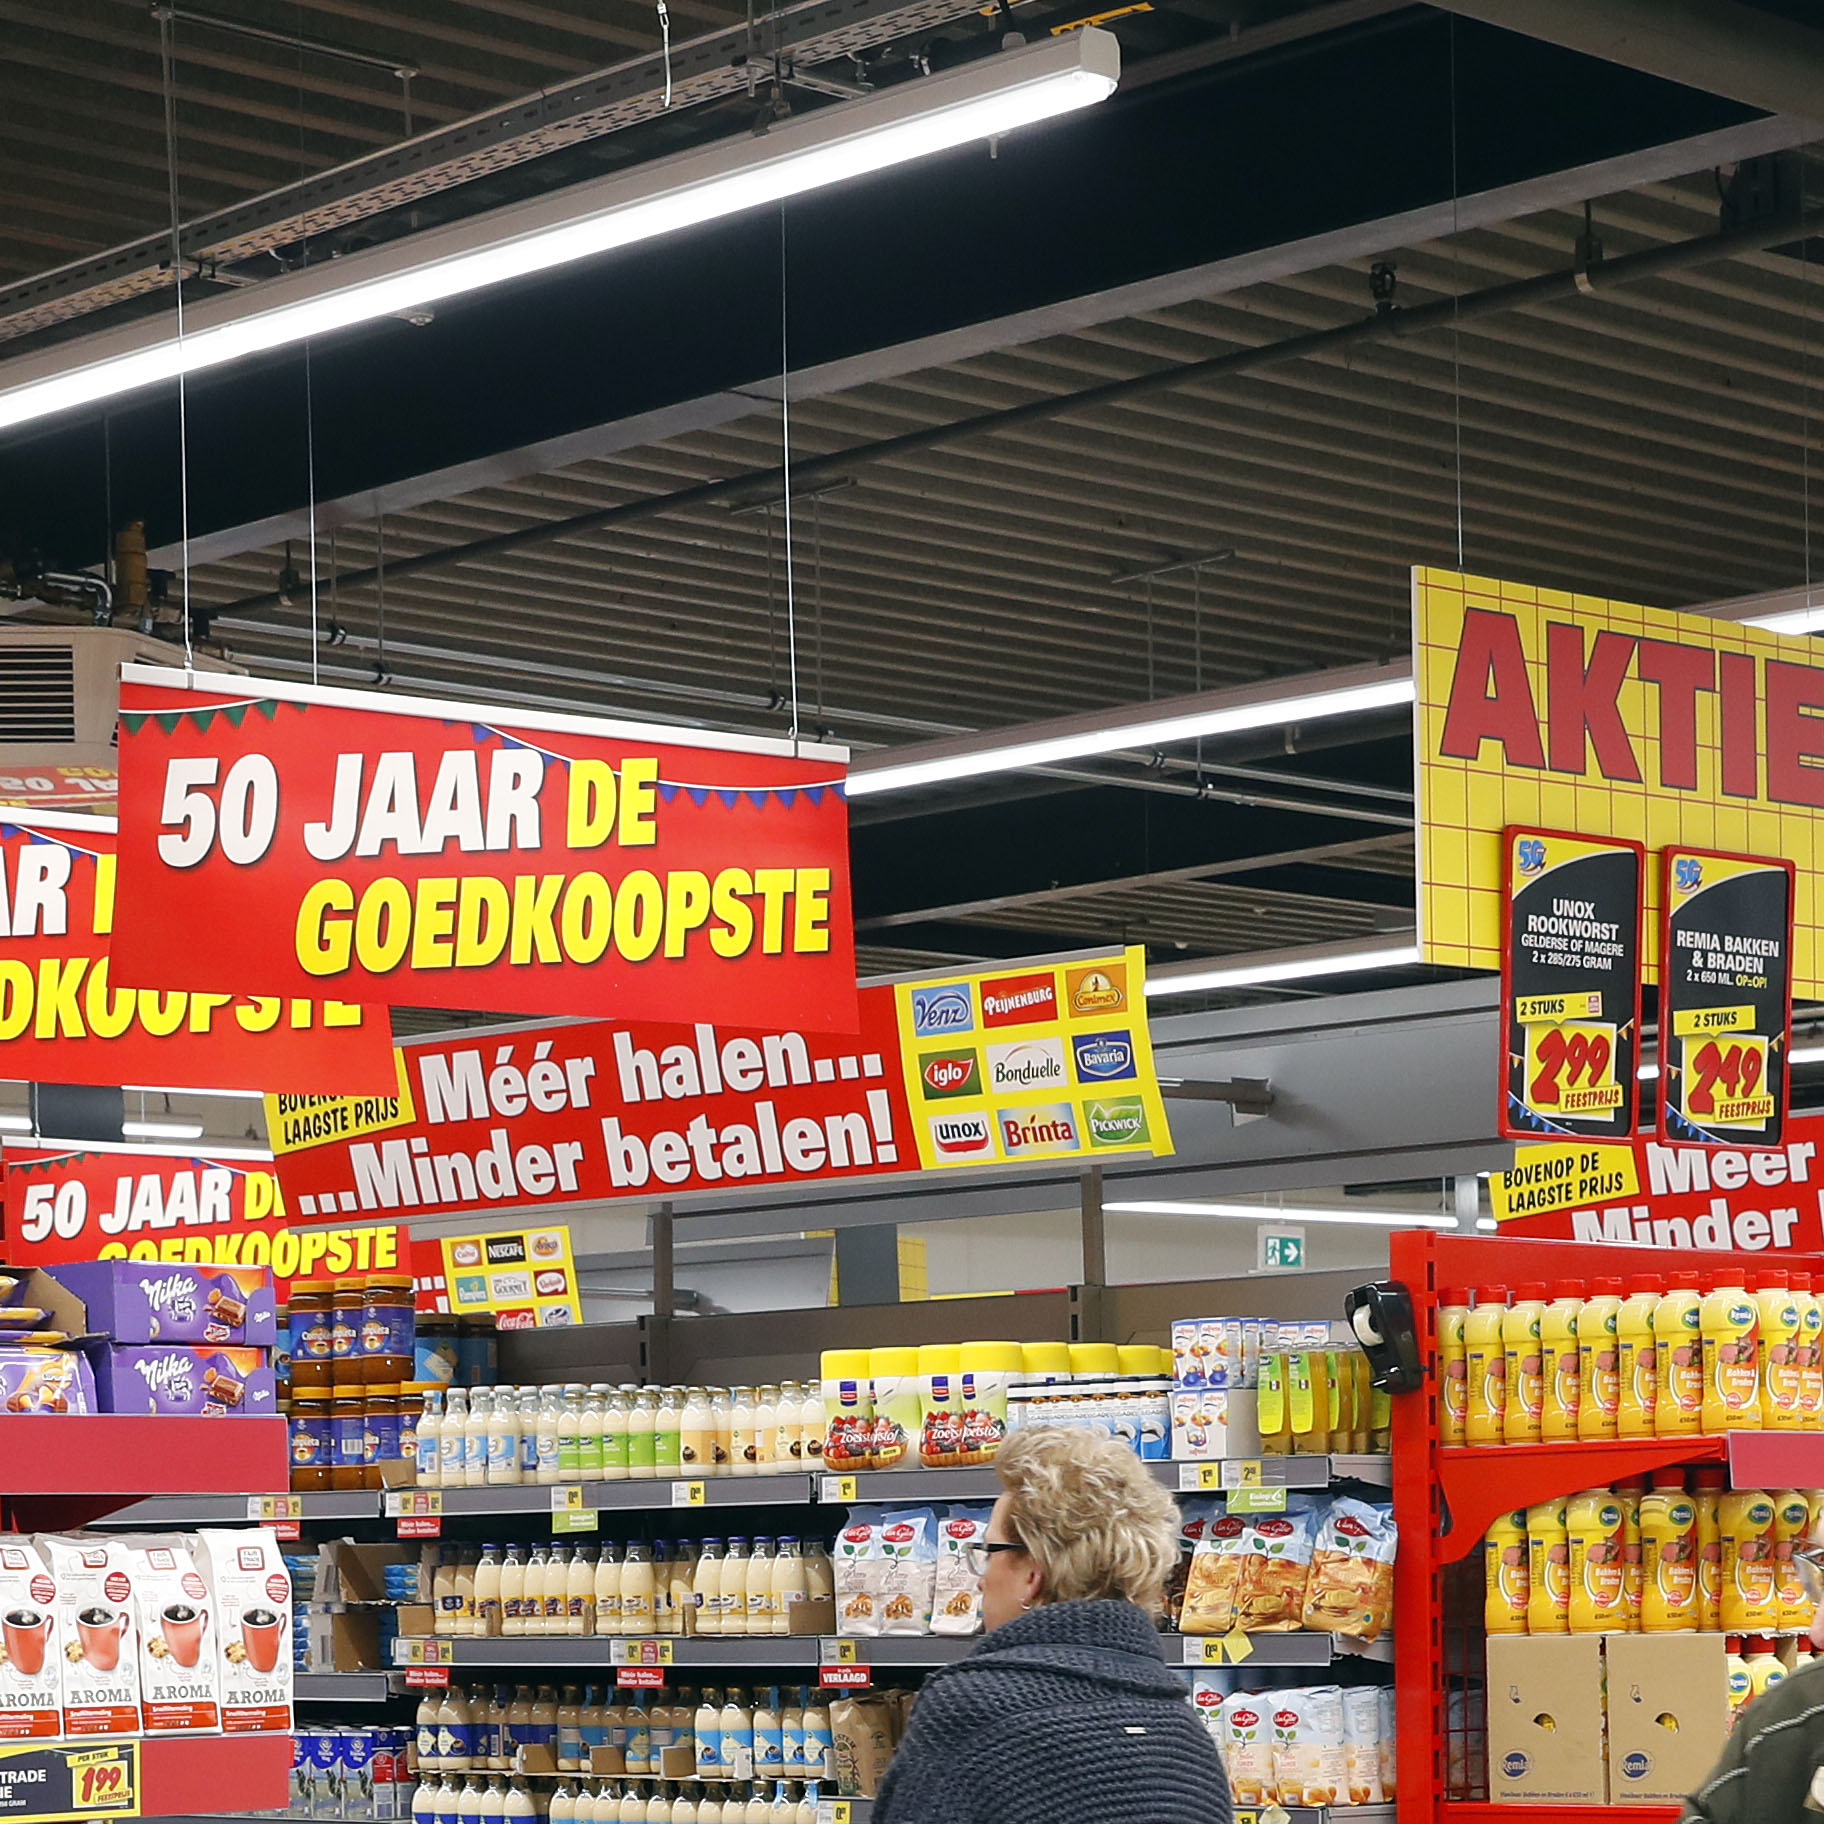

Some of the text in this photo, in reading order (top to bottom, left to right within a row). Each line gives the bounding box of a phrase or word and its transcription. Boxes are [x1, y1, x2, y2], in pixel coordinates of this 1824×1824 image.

[155, 750, 277, 872] 50
[302, 743, 544, 861] JAAR
[563, 757, 660, 849] DE
[295, 865, 833, 978] GOEDKOOPSTE
[1552, 898, 1596, 919] UNOX
[1527, 914, 1620, 941] ROOKWORST
[1521, 933, 1624, 957] GELDERSE OF MAGERE
[1676, 929, 1780, 958] REMIA BAKKEN
[1532, 950, 1612, 971] 2 285/275 GRAM
[1692, 950, 1764, 975] & BRADEN
[1686, 969, 1693, 982] 2
[1700, 971, 1717, 985] 650
[915, 990, 969, 1029] Venz
[1520, 999, 1565, 1016] 2 STUKS
[1694, 1011, 1738, 1027] 2 STUKS
[419, 1022, 884, 1126] Méér halen...
[933, 1048, 1125, 1086] iglo Bonduelle Bavaria
[1530, 1028, 1611, 1104] 299
[1688, 1041, 1763, 1114] 249
[1564, 1089, 1619, 1109] FEESTPRIJS
[1718, 1100, 1772, 1119] FEESTPRIJS
[283, 1096, 399, 1145] LAAGSTE PRIJS
[939, 1118, 984, 1140] unox
[1003, 1112, 1075, 1147] Brinta
[298, 1088, 899, 1210] ...Minder betalen!
[1503, 1151, 1600, 1190] BOVENOP DE
[21, 1169, 233, 1242] 50 JAAR
[1507, 1171, 1624, 1213] LAAGSTE PRIJS
[138, 1269, 200, 1308] Milka
[134, 1351, 196, 1387] Milka
[152, 1685, 212, 1700] AROMA
[822, 1673, 867, 1685] VERLAAGD
[70, 1687, 133, 1704] AROMA
[226, 1688, 287, 1704] AROMA
[77, 1751, 109, 1763] PER STUK
[0, 1769, 46, 1784] TRADE
[82, 1767, 122, 1803] 199
